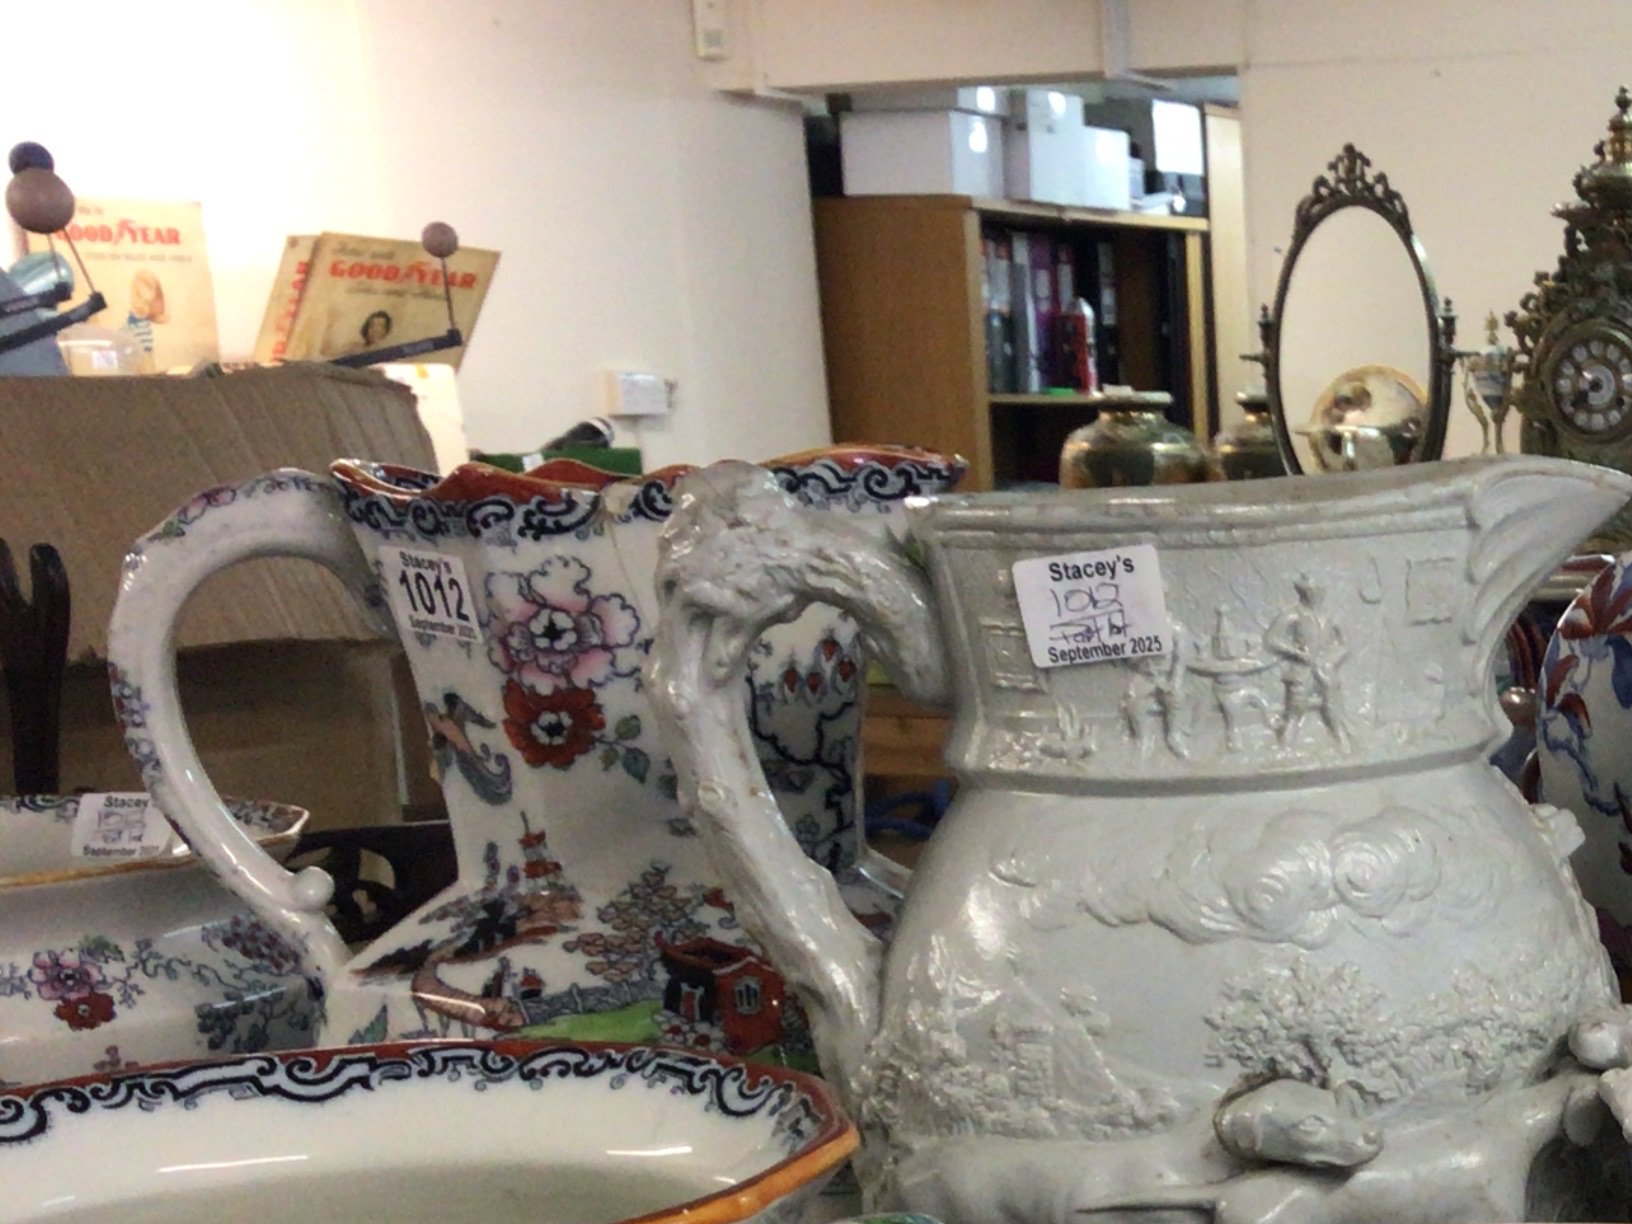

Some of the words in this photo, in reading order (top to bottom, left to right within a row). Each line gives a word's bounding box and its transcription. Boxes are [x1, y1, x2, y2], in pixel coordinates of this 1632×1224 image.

[1048, 555, 1135, 582] Stacey's
[400, 570, 470, 621] 1012
[1049, 582, 1124, 618] 1012
[1048, 641, 1126, 664] September
[1129, 635, 1163, 655] 2025
[103, 795, 150, 815] Stacey
